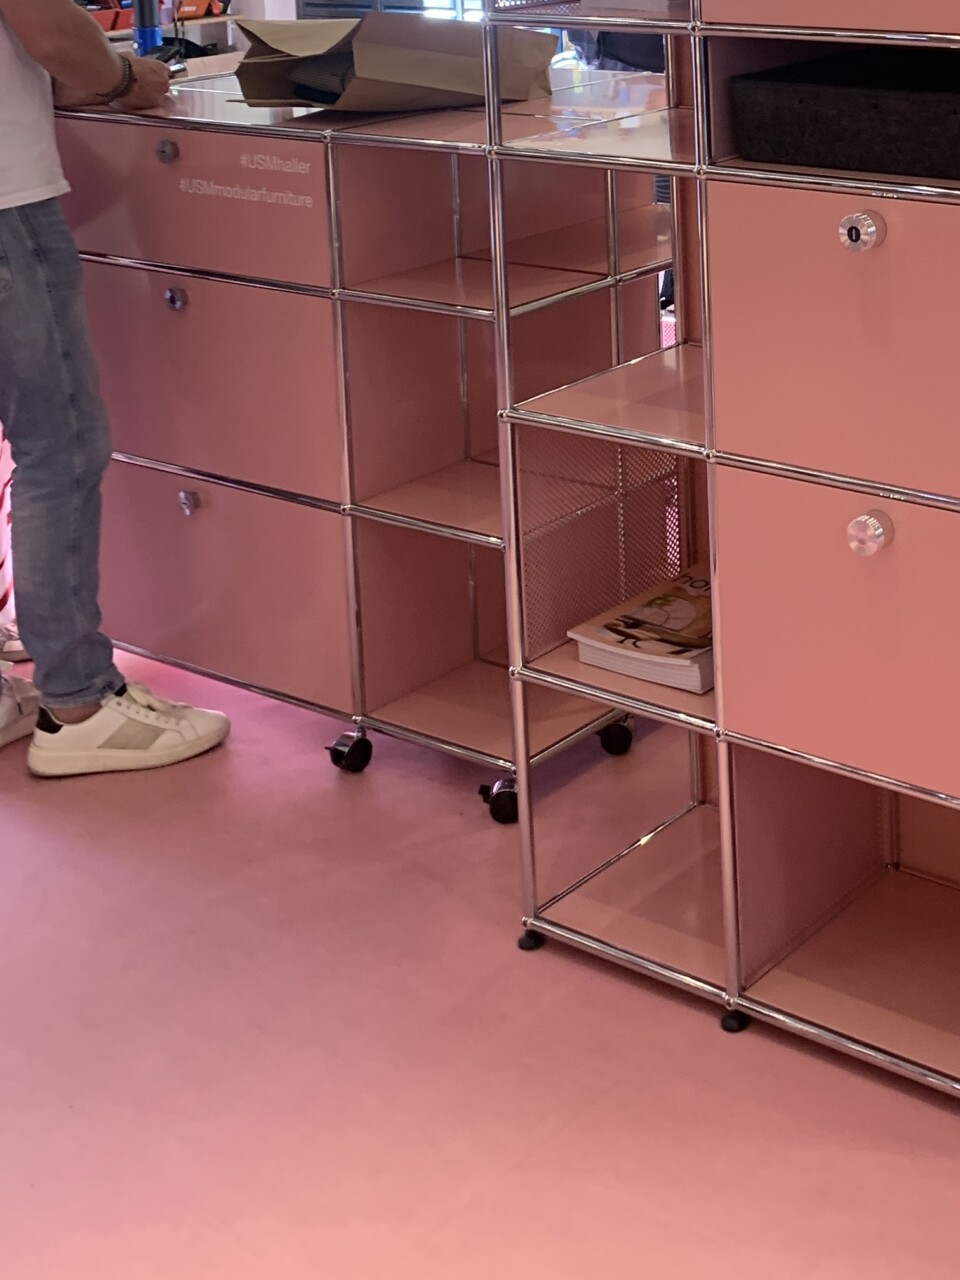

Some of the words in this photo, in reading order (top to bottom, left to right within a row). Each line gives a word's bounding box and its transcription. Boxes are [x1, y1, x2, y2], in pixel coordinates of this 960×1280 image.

[240, 153, 311, 175] #USMhaller
[179, 177, 314, 209] #USMmodularfurniture
[672, 572, 711, 592] ho
